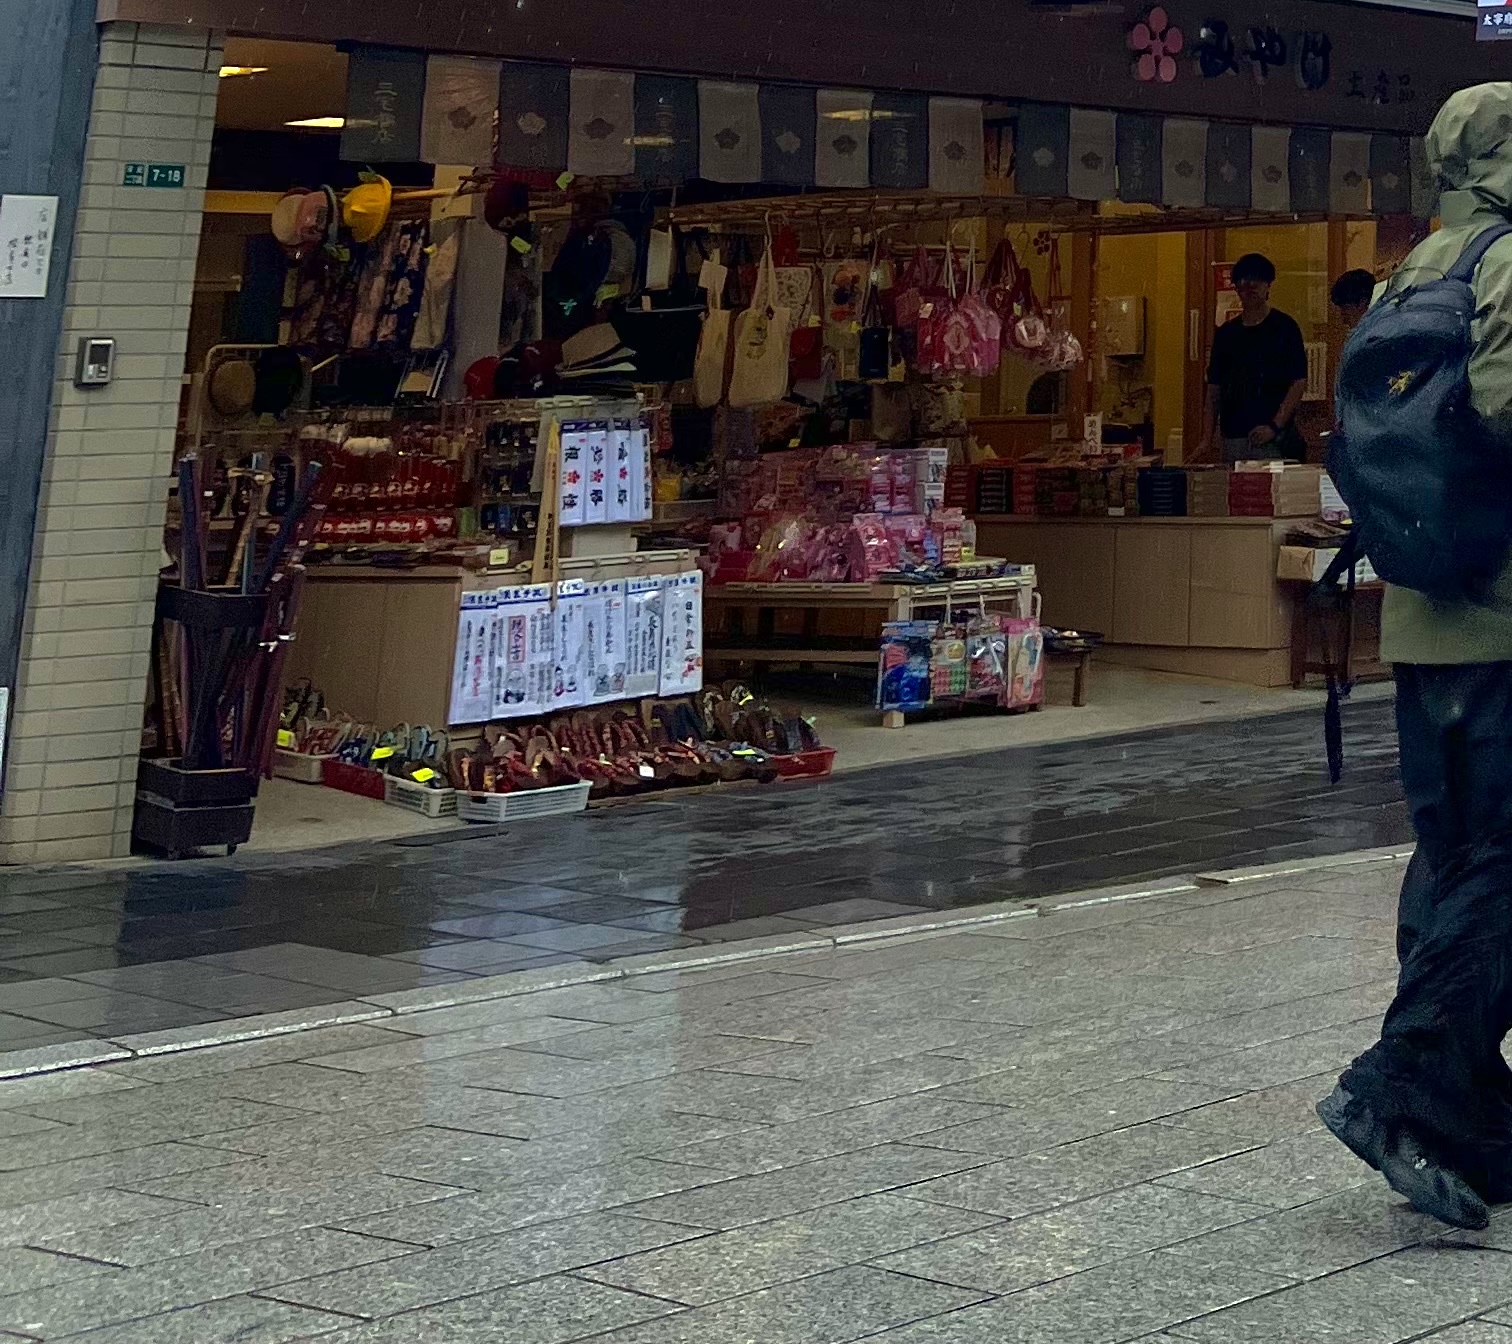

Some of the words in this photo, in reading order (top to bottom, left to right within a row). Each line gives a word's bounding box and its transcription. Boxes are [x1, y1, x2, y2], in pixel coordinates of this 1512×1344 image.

[1346, 67, 1415, 105] 土産品
[152, 168, 181, 183] 7-18
